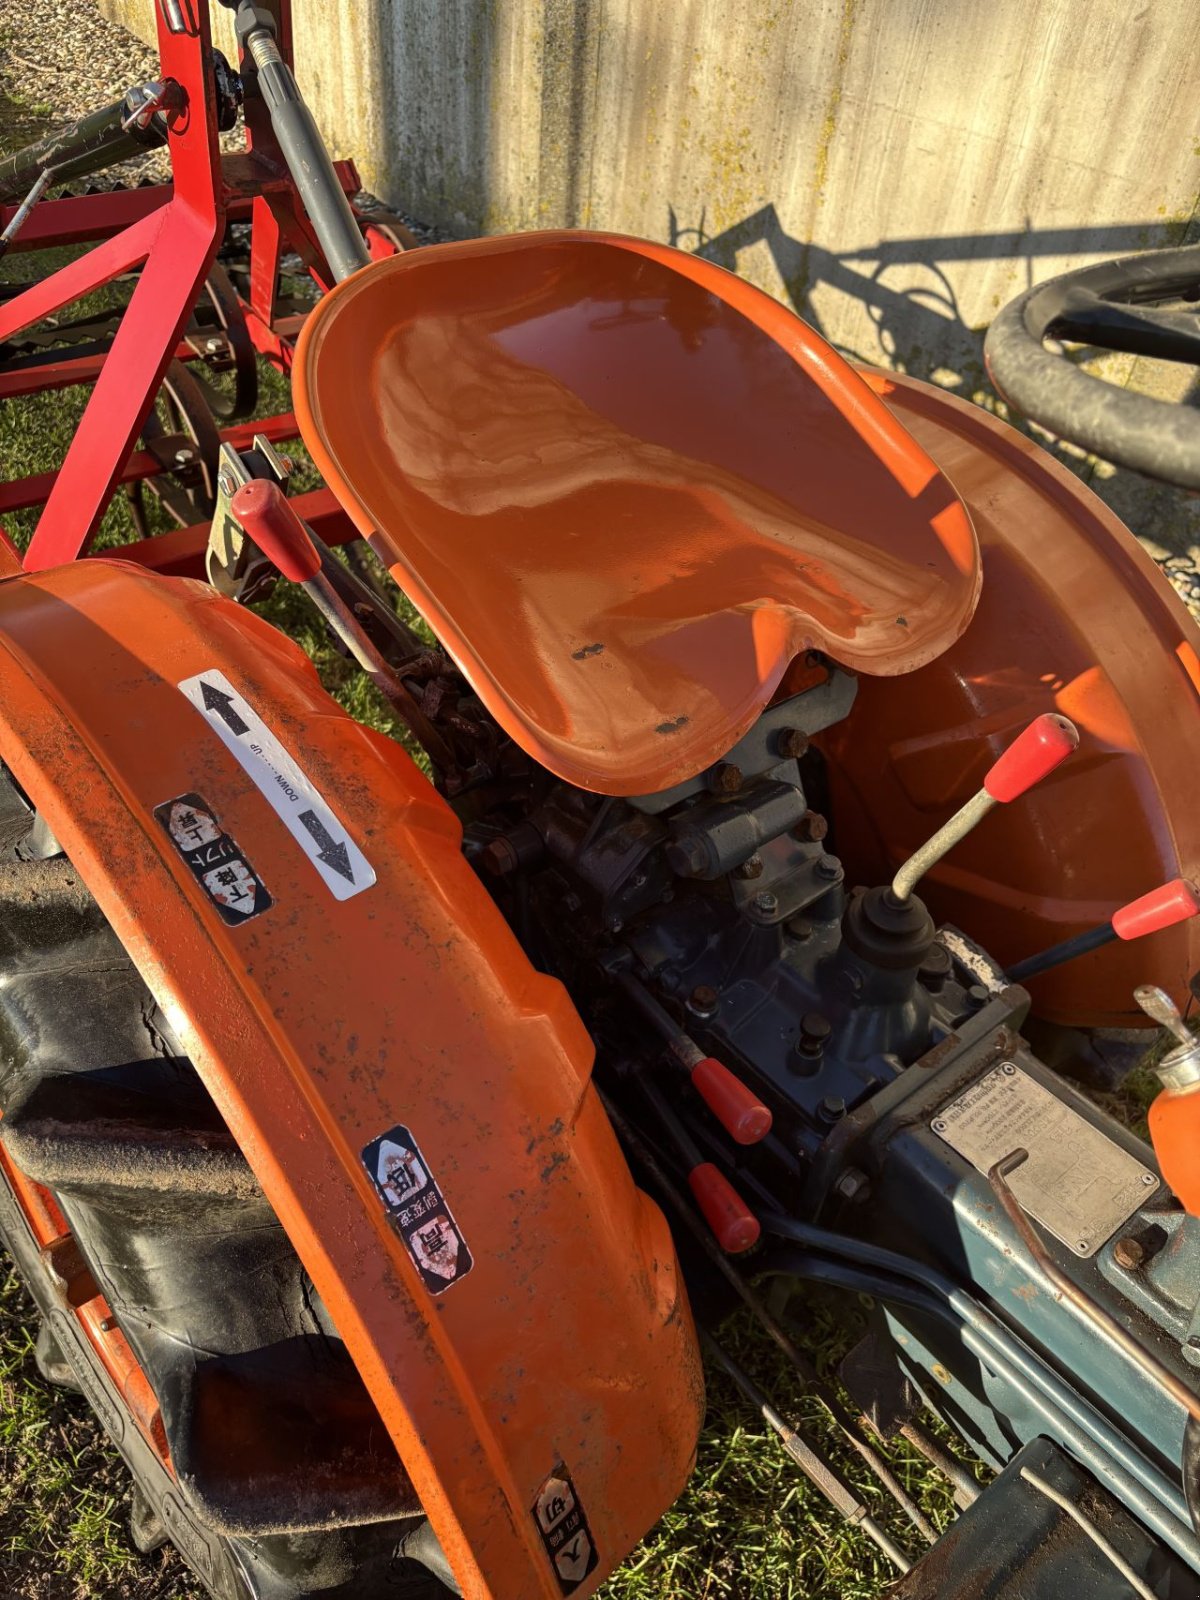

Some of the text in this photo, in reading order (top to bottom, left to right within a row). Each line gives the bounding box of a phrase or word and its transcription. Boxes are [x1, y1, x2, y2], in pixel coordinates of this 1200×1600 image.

[274, 774, 299, 802] DOWN
[177, 811, 202, 842] 上昇
[191, 842, 233, 867] リフト
[214, 867, 249, 904] 下降
[387, 1164, 415, 1197] 低
[420, 1223, 448, 1256] 高
[545, 1496, 565, 1523] 切
